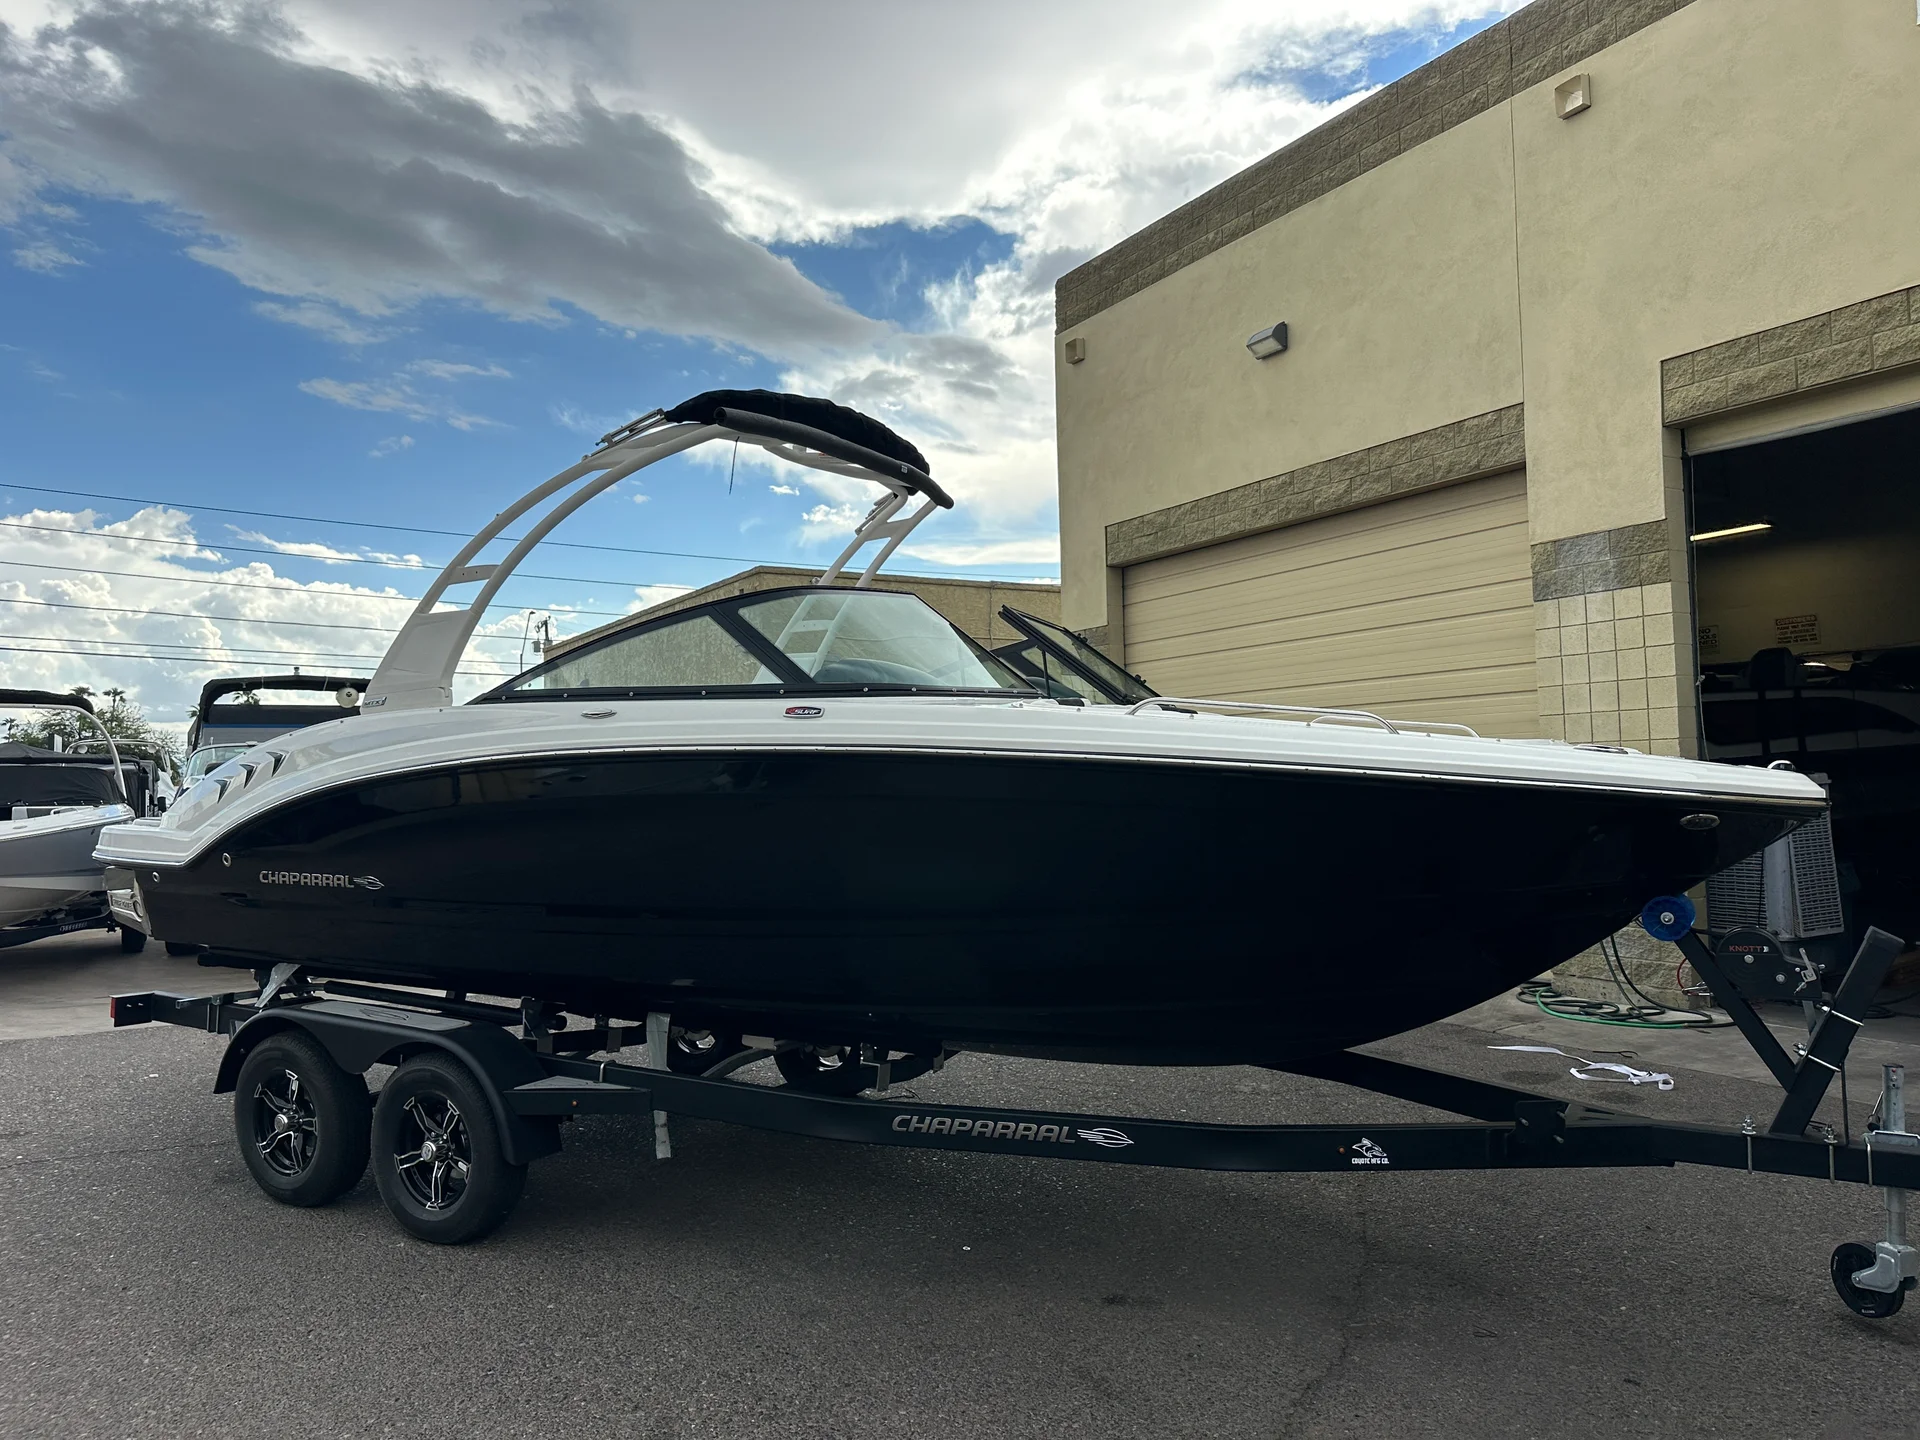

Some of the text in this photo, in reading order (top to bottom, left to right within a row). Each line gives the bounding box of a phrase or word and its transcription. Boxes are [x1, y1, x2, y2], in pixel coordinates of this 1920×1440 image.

[1776, 615, 1816, 625] CUSTOMERS
[259, 870, 355, 889] CHAPARRAL
[892, 1115, 1076, 1144] CHAPARRAL
